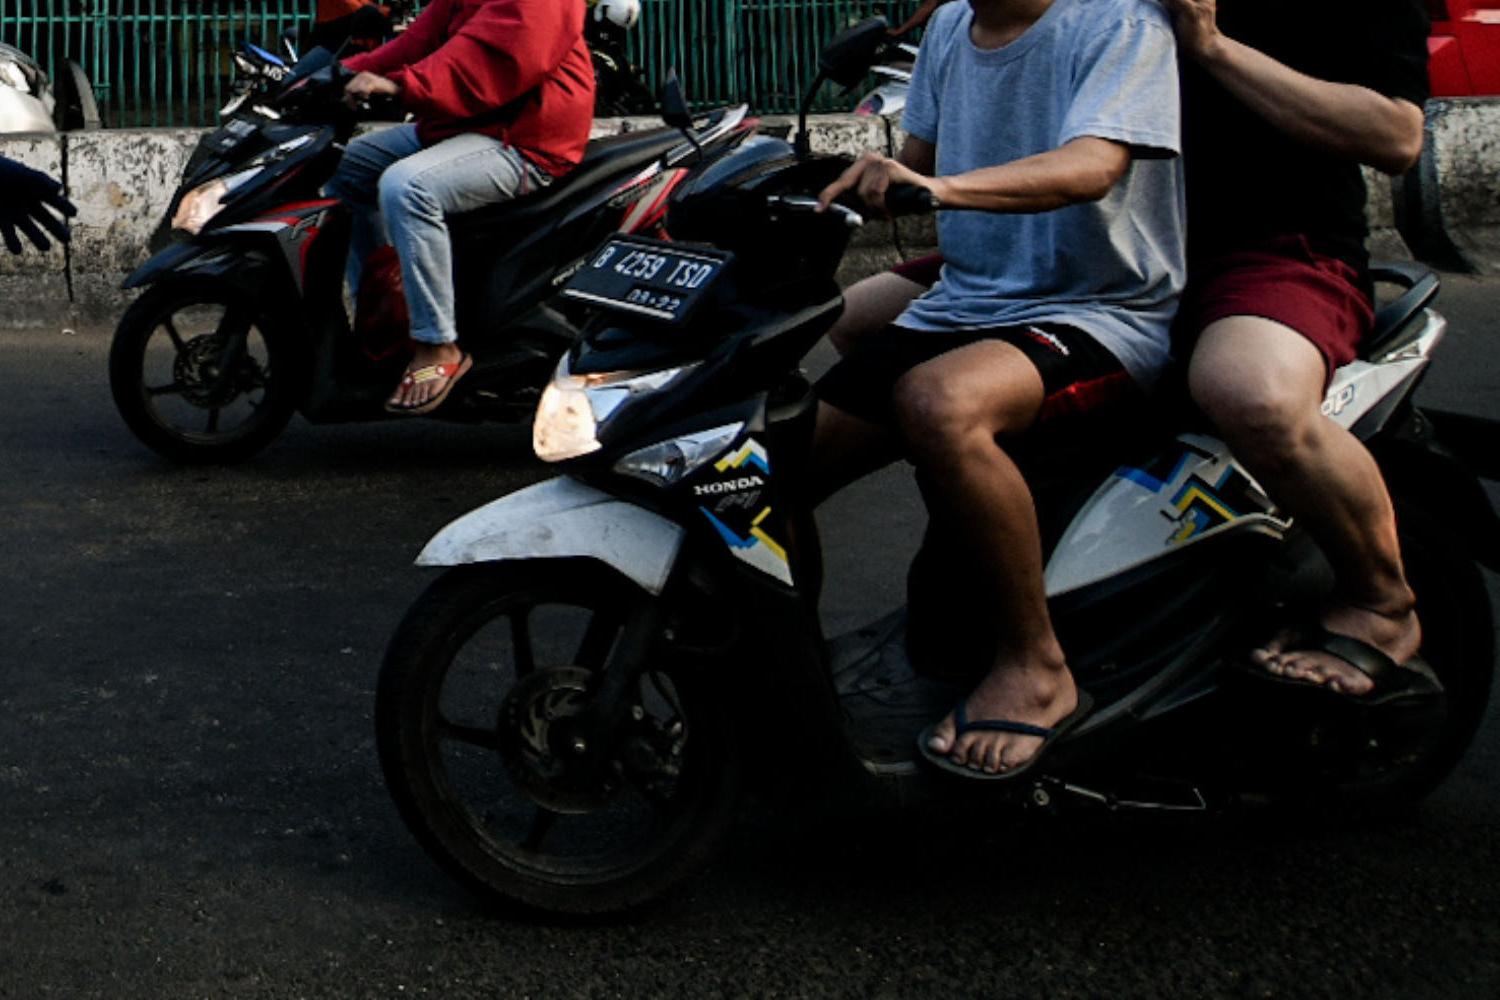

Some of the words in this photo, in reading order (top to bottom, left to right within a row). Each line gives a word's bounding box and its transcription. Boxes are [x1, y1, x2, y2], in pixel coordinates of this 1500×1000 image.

[593, 246, 616, 268] B
[613, 250, 667, 281] 4259
[693, 475, 765, 496] HONDA
